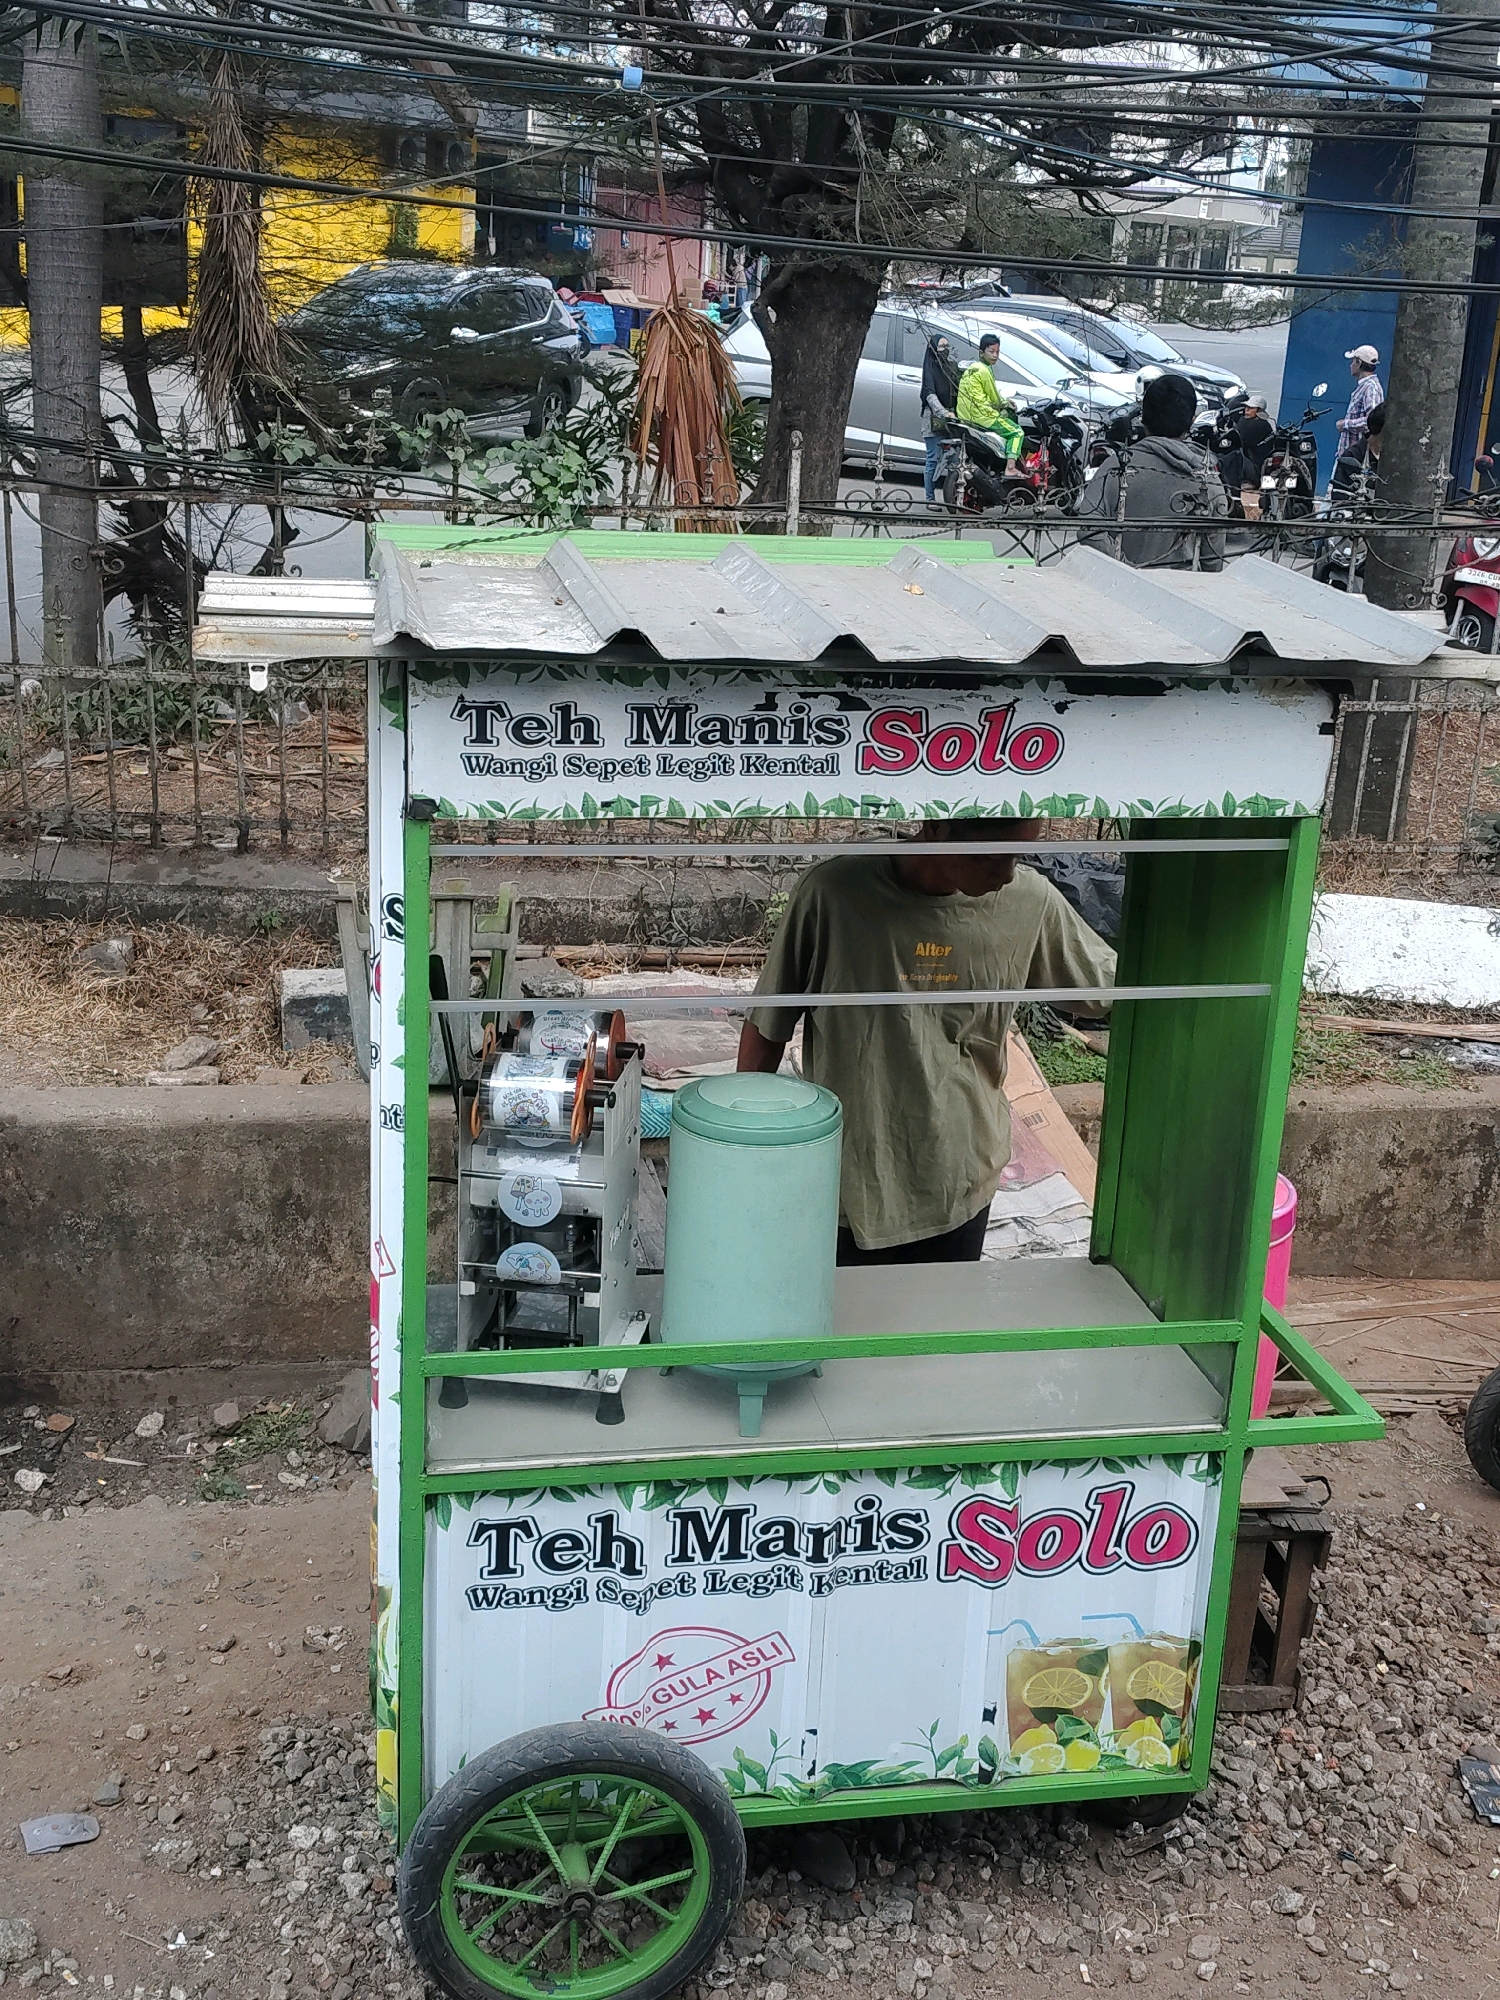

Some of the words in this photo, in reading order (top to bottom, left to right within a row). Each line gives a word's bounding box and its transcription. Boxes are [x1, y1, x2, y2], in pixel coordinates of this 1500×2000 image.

[451, 701, 604, 748] Teh
[625, 702, 850, 748] Manis
[856, 704, 1064, 776] Solo
[460, 753, 558, 783] Wangi
[563, 754, 650, 783] Sepet
[656, 752, 734, 782] Legit
[740, 753, 840, 776] Kental
[466, 1510, 646, 1580] Teh
[665, 1494, 931, 1567] Manis
[937, 1481, 1199, 1589] Solo
[465, 1577, 589, 1612] Wangi
[596, 1572, 697, 1616] Sepet
[704, 1565, 804, 1598] Legit
[809, 1556, 928, 1598] Kental
[652, 1668, 725, 1704] GULA
[728, 1641, 783, 1676] ASLI
